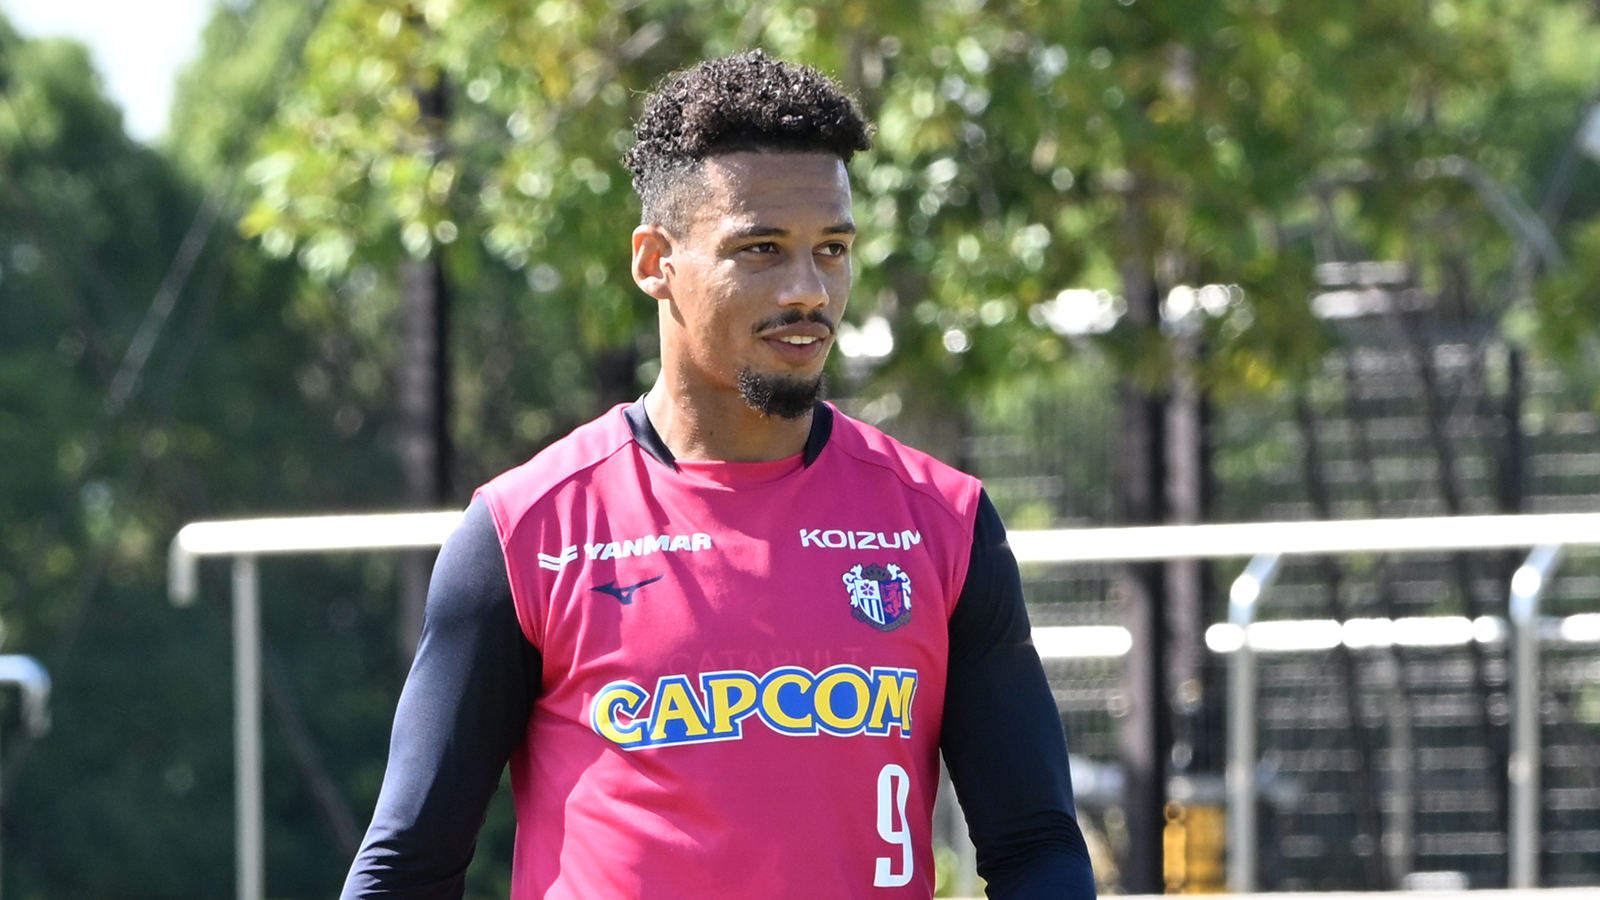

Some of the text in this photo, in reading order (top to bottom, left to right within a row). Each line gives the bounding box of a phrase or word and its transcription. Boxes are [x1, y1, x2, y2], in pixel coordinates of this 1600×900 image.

[583, 533, 712, 560] YANMAR
[590, 664, 917, 751] CAPCOM
[873, 763, 914, 888] 9
